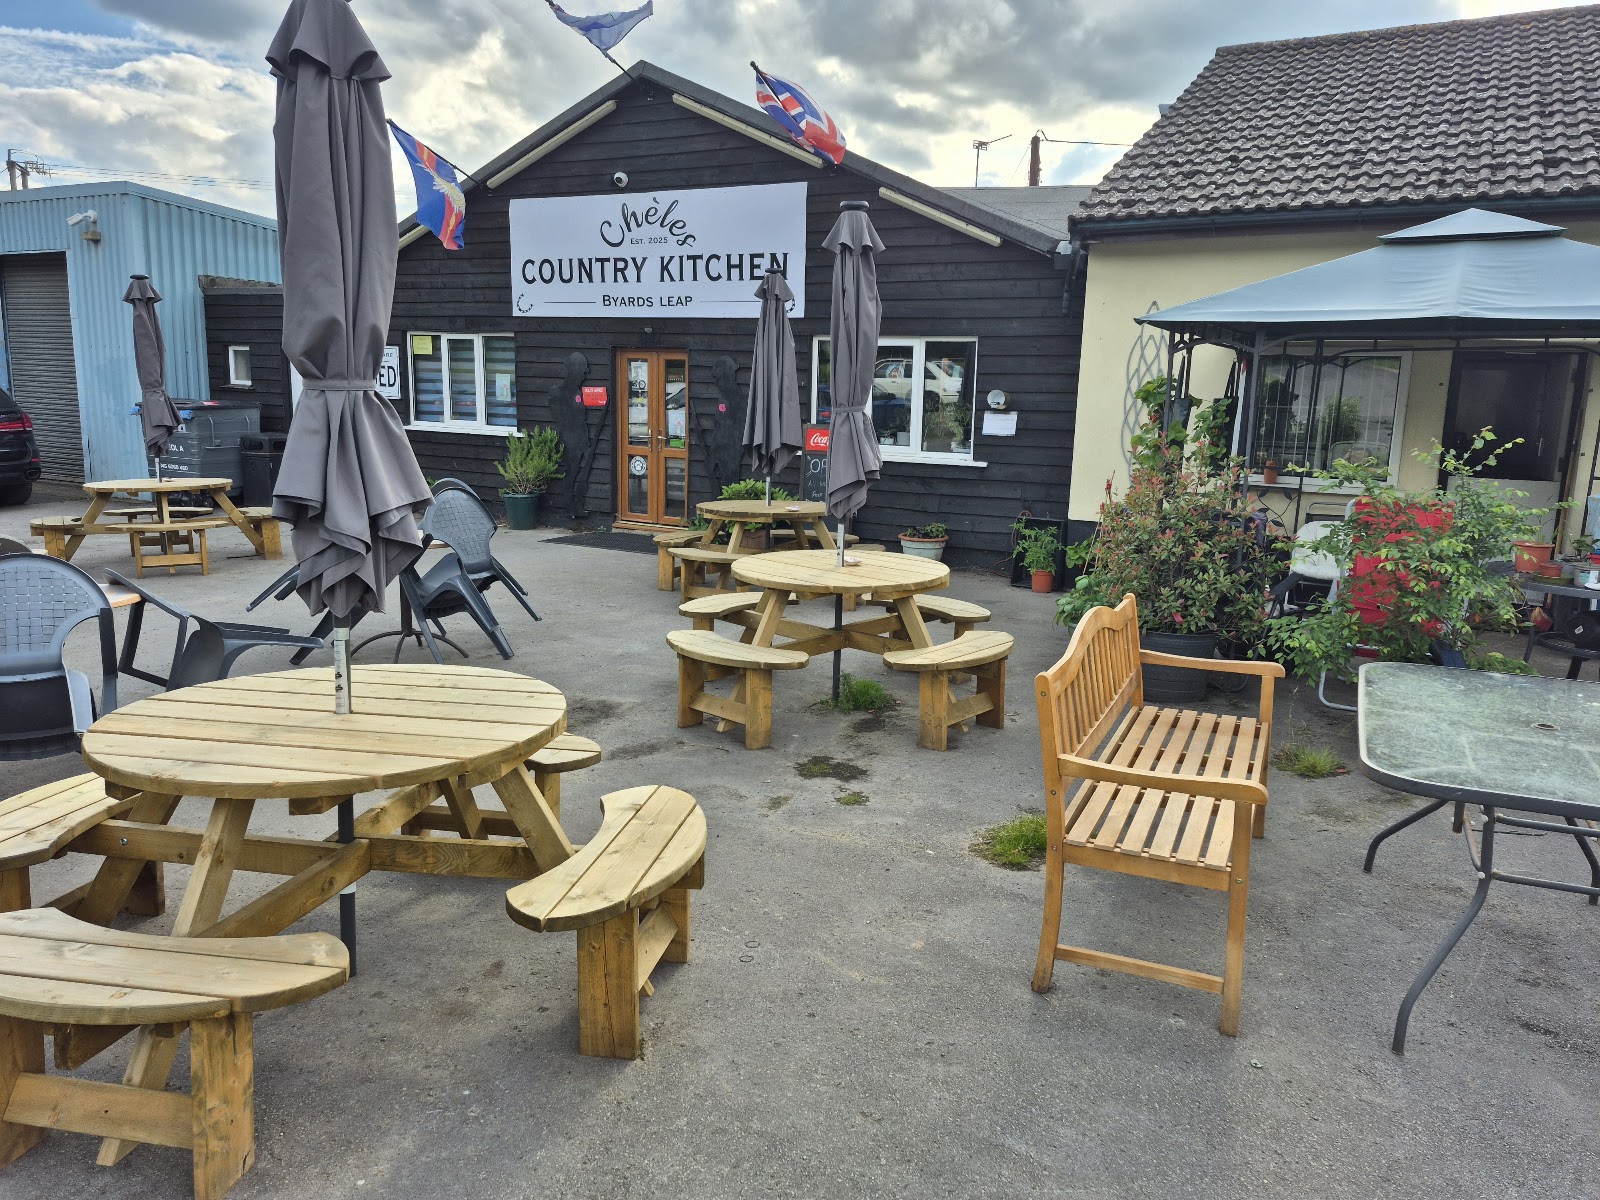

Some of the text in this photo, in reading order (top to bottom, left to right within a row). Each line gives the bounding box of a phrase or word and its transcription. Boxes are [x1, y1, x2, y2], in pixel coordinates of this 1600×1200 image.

[600, 196, 696, 248] Chèles
[521, 252, 789, 285] COUNTRY KITCHEN
[659, 296, 693, 307] LEAP
[375, 366, 396, 387] ED
[811, 433, 829, 446] Coca
